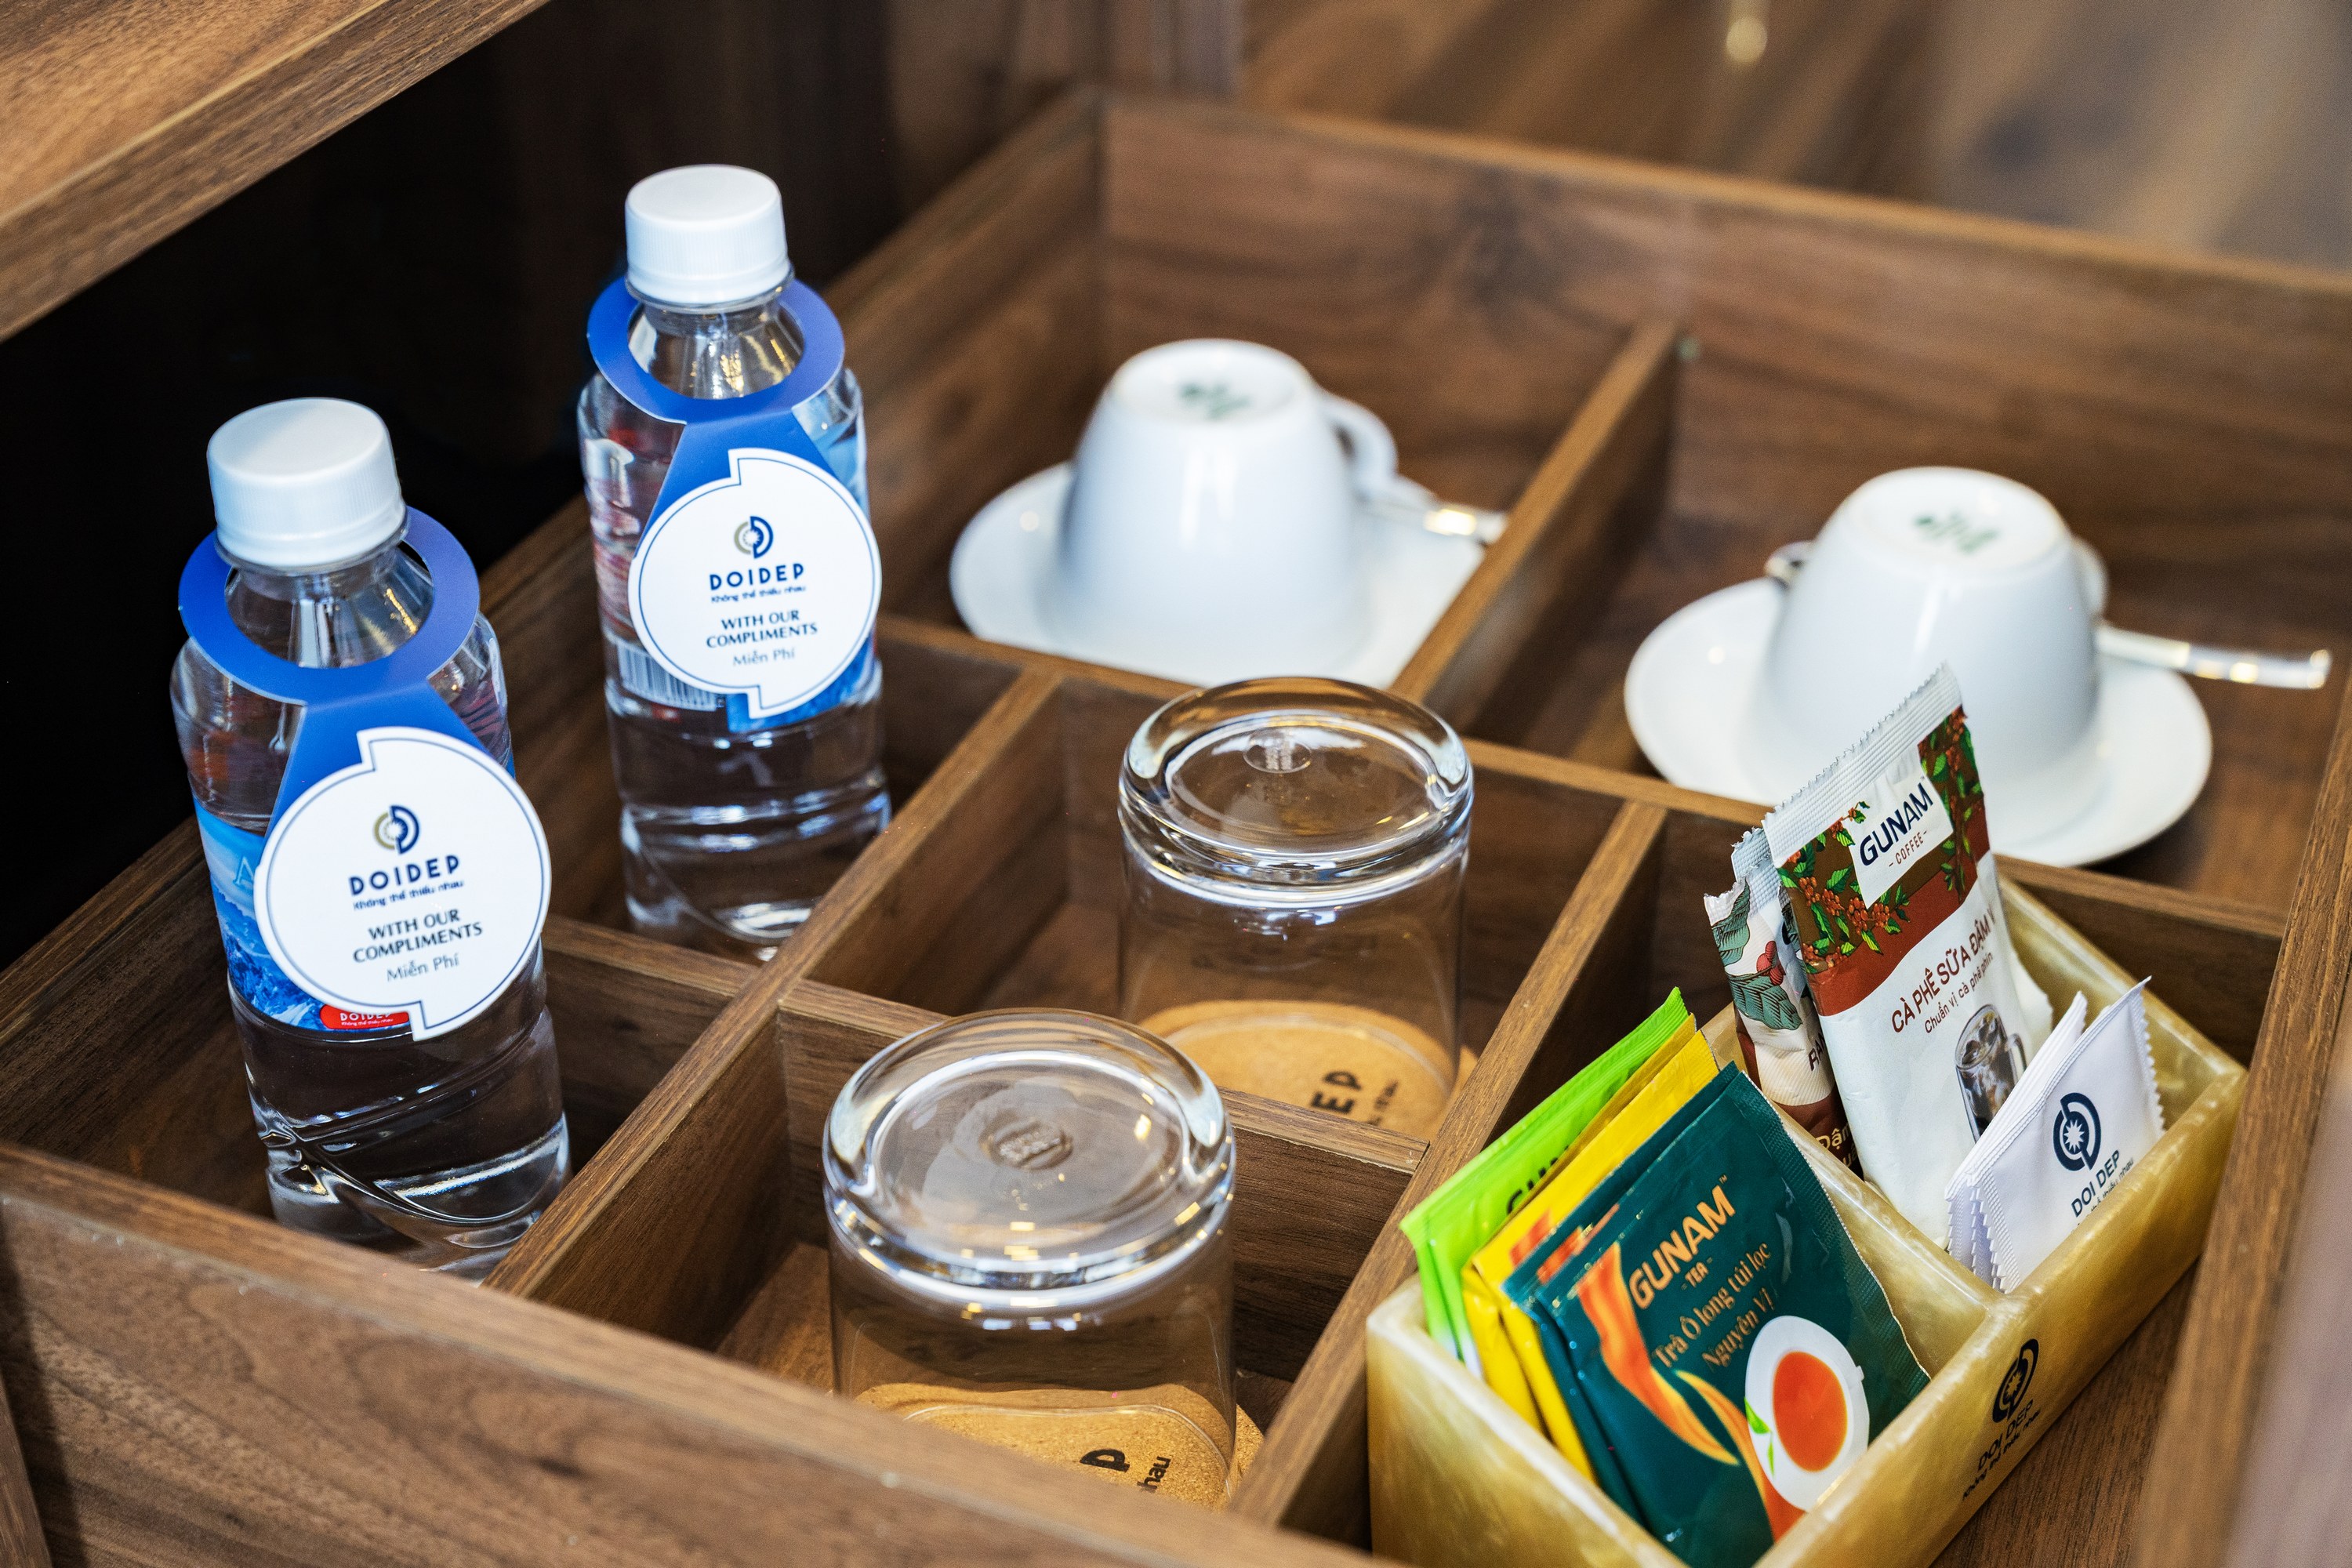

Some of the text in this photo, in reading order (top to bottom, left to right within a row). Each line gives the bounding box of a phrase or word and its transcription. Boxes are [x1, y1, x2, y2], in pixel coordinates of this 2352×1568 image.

[709, 562, 804, 591] DOIDEP
[706, 621, 818, 648] COMPLIMENTS
[721, 609, 800, 630] WITH OUR
[772, 647, 796, 660] Phí
[1860, 782, 1934, 866] GUNAM
[1895, 832, 1924, 865] COFFEE
[349, 855, 460, 896] DOIDEP
[353, 921, 483, 963] COMPLIMENTS
[368, 908, 460, 941] WITH OUR
[387, 952, 460, 982] Miễn Phí
[1892, 996, 1915, 1033] CÀ
[1911, 967, 1940, 1014] PHÊ
[1936, 945, 1971, 985] SỮA
[1969, 914, 1992, 956] ĐẬM
[1924, 1000, 1951, 1033] Chuẩn
[1948, 992, 1959, 1007] vị
[1958, 982, 1969, 999] cà
[2071, 1181, 2096, 1218] DOI
[2096, 1149, 2120, 1189] DEP
[1628, 1185, 1737, 1310] GUNAM
[1684, 1261, 1710, 1288] TEA
[1652, 1242, 1771, 1368] Trà Ô long túi lọc
[1701, 1287, 1776, 1371] Nguyên Vị
[1977, 1399, 2034, 1471] DOI DEP
[1136, 1455, 1172, 1489] hau
